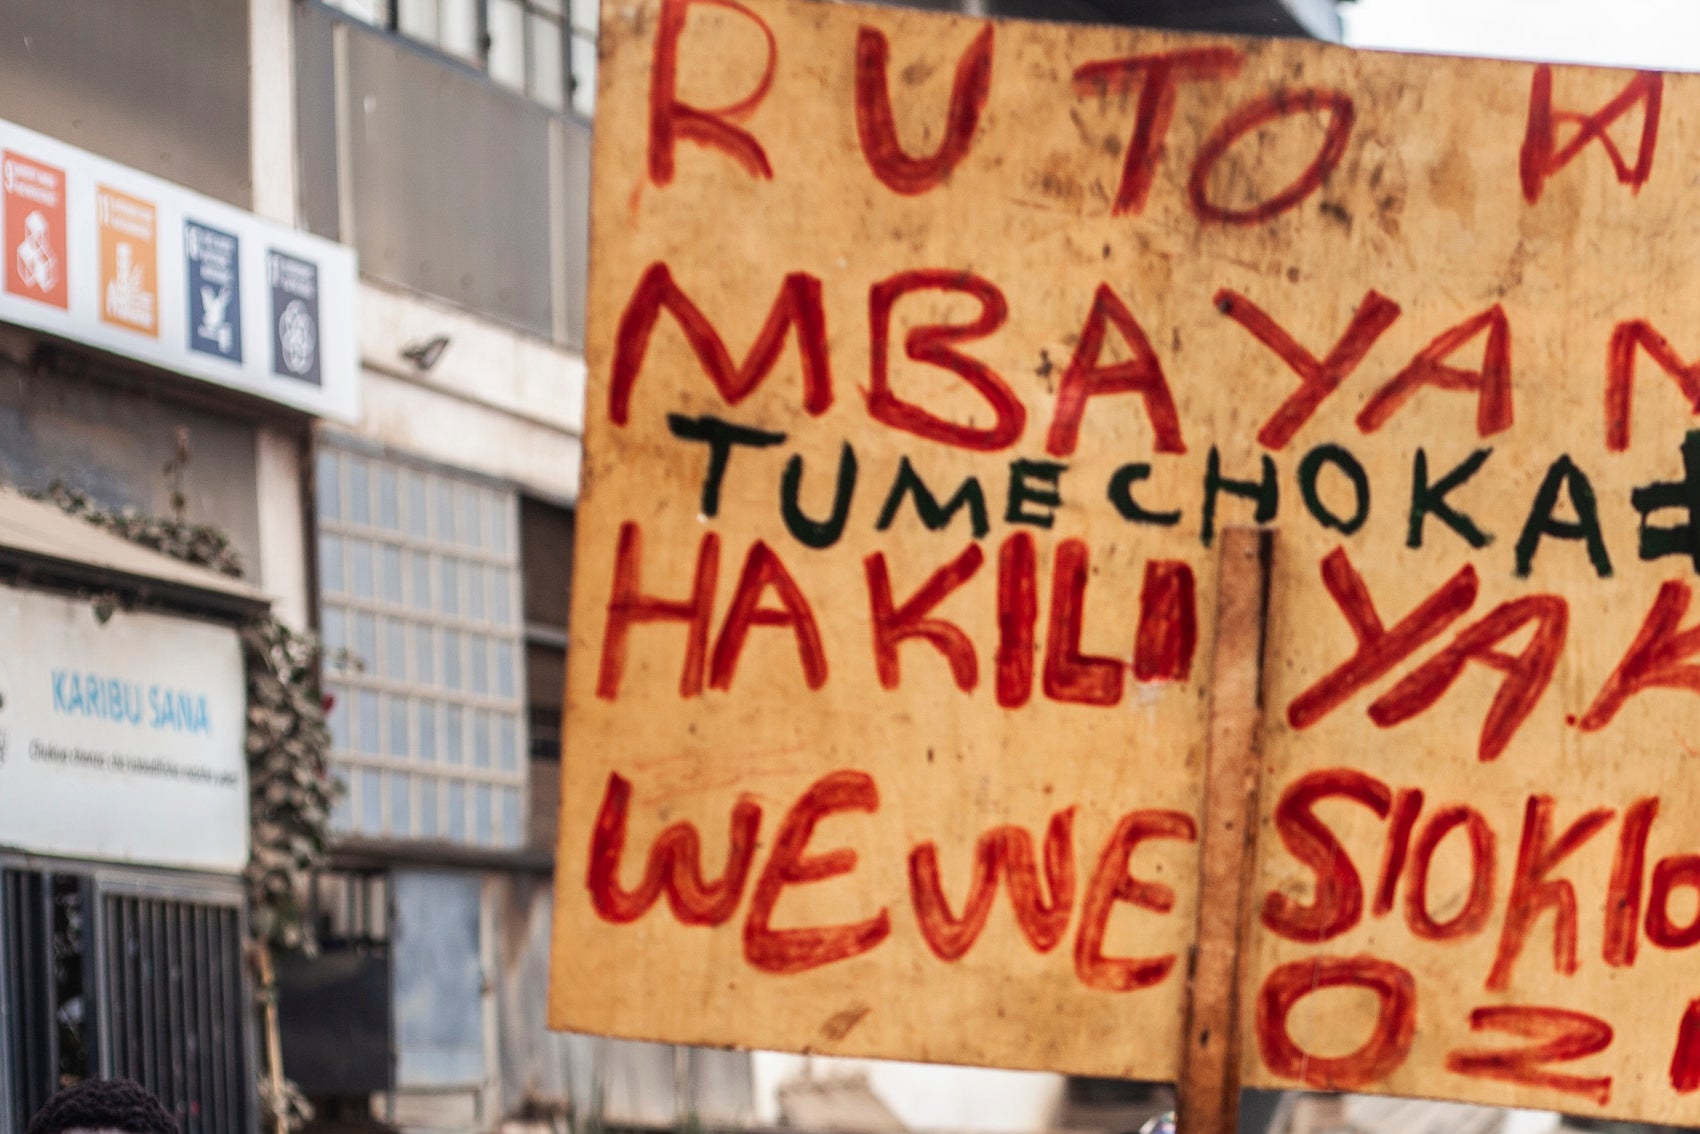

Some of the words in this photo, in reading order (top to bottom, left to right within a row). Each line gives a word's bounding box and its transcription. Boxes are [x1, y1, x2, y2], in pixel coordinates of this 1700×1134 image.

[648, 0, 1354, 228] RUTO
[607, 262, 1514, 457] MBAYA
[51, 669, 144, 726] KARIBU
[149, 685, 211, 734] SANA
[585, 770, 1199, 993] WEWE
